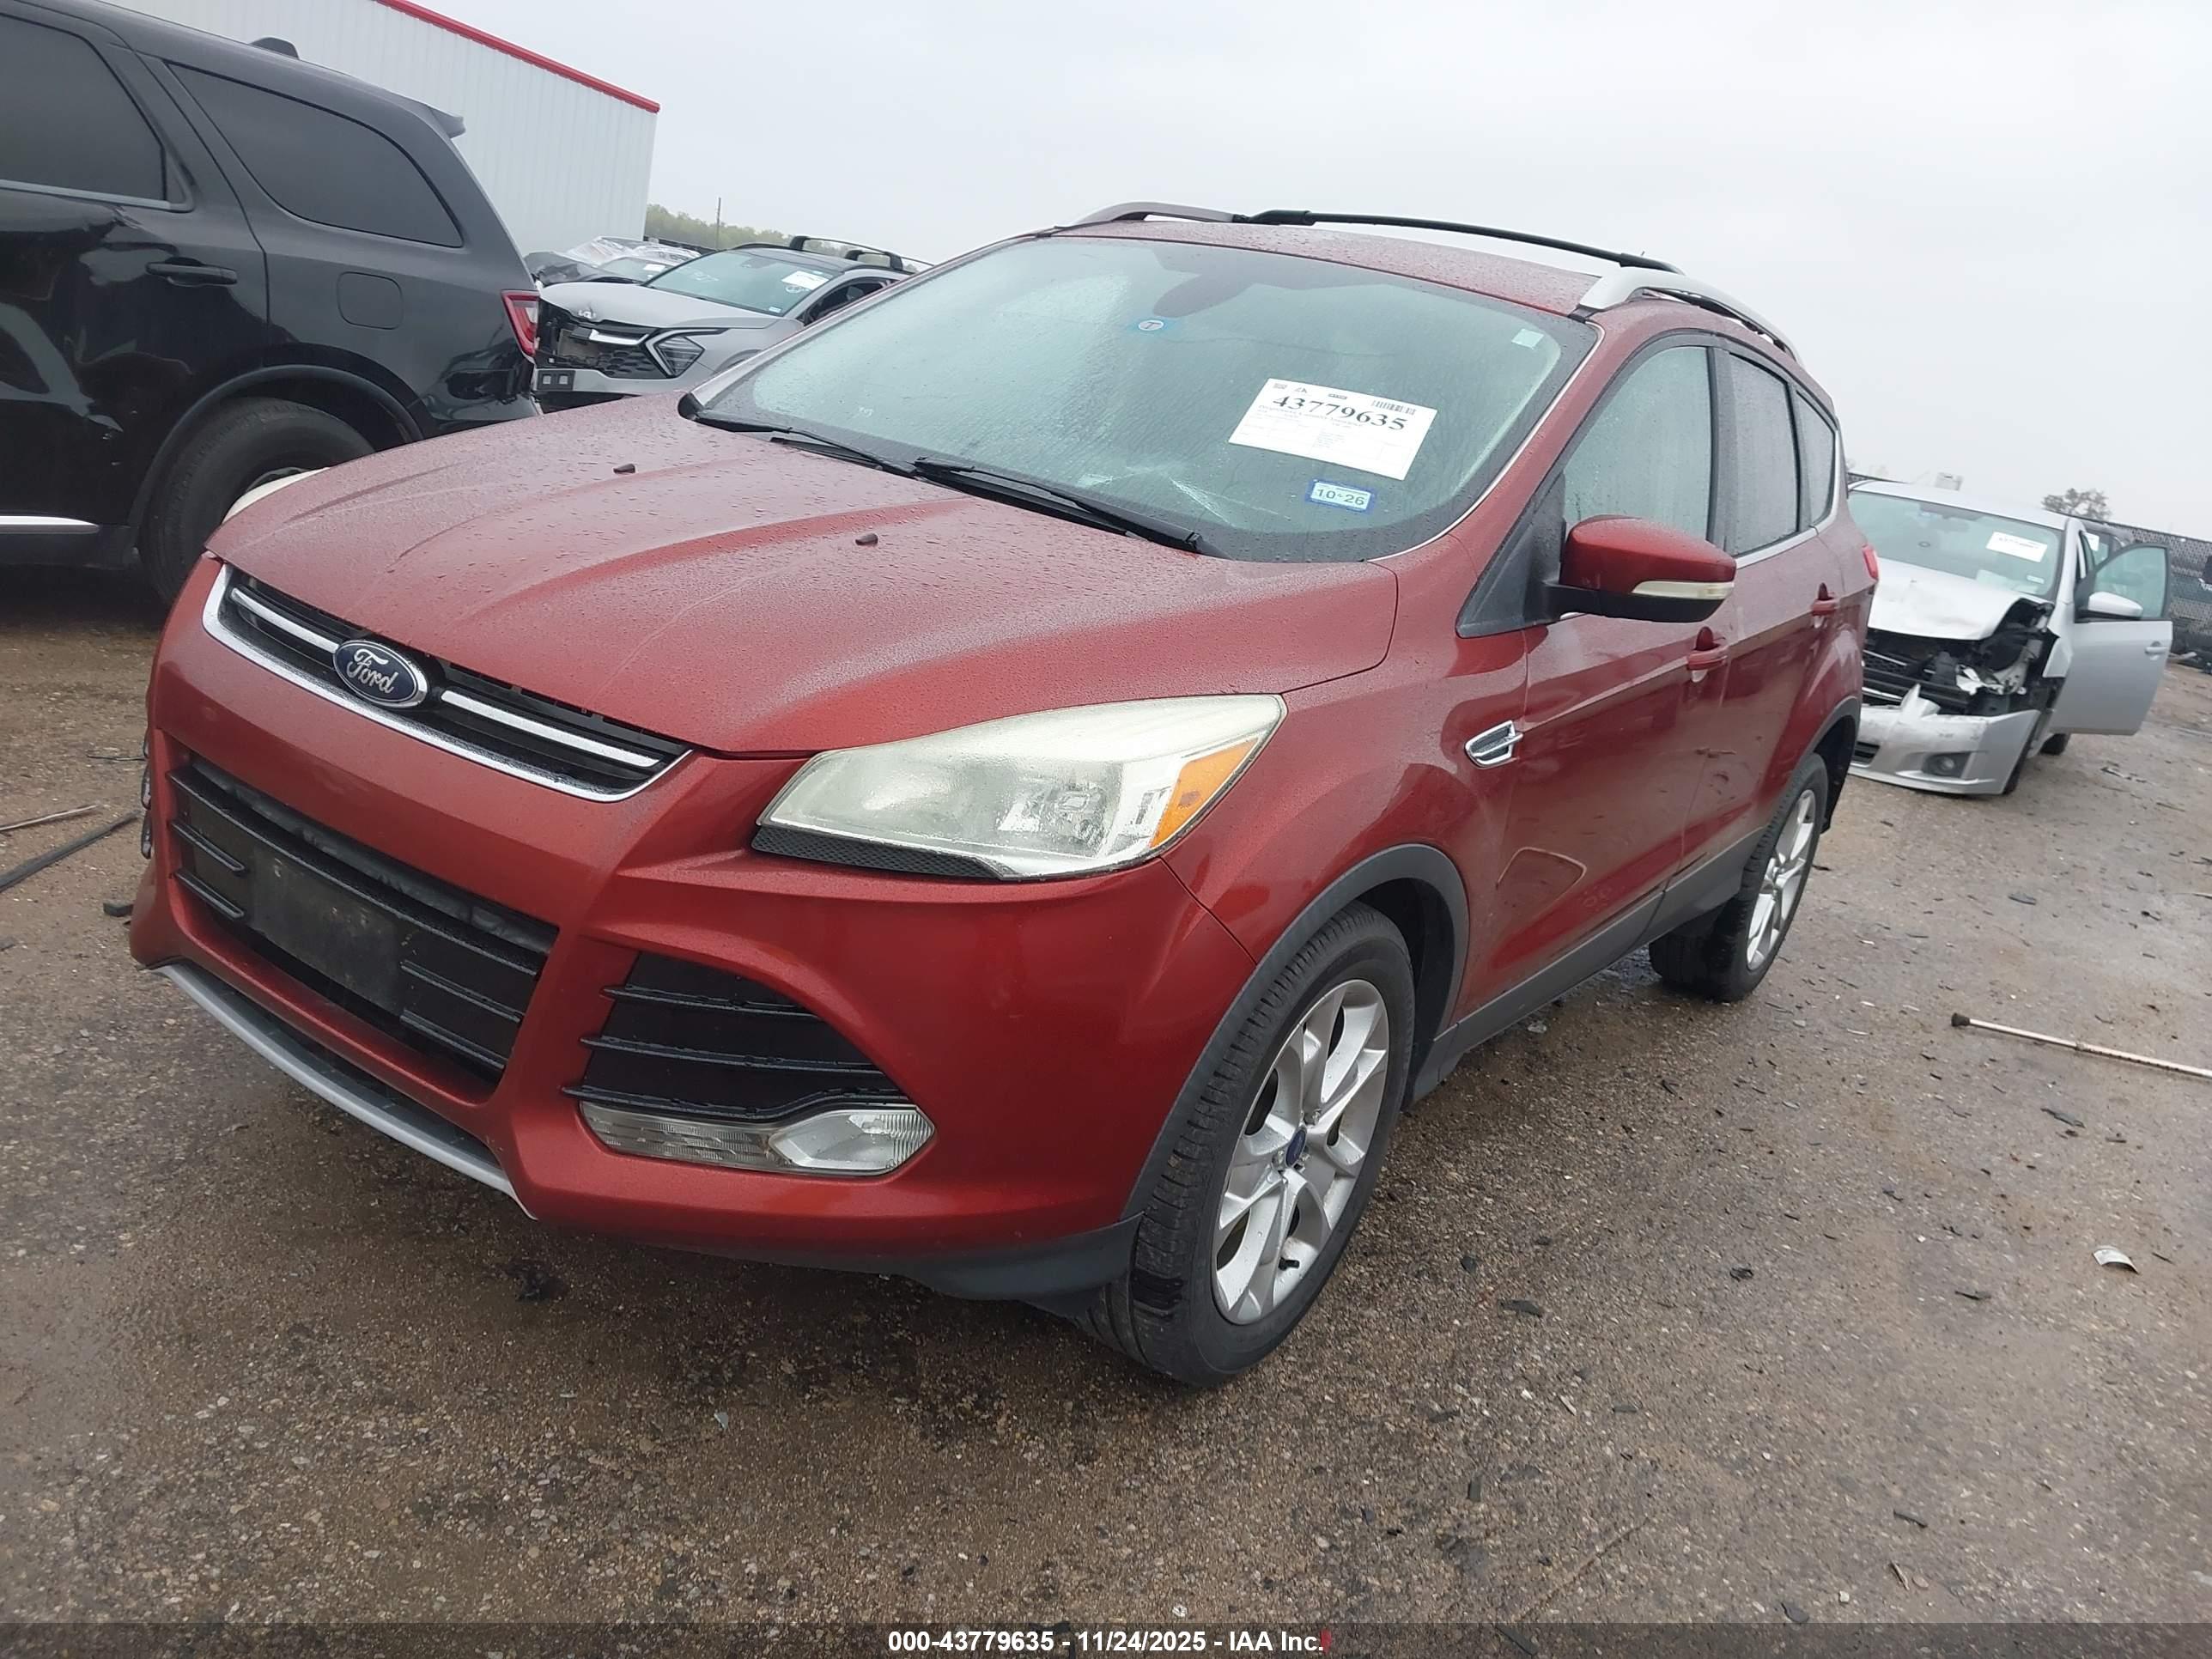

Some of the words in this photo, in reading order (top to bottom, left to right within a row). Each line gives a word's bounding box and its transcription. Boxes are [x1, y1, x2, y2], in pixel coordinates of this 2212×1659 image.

[1272, 395, 1408, 431] 43779635
[1316, 489, 1365, 506] 10-26
[346, 648, 399, 694] Ford
